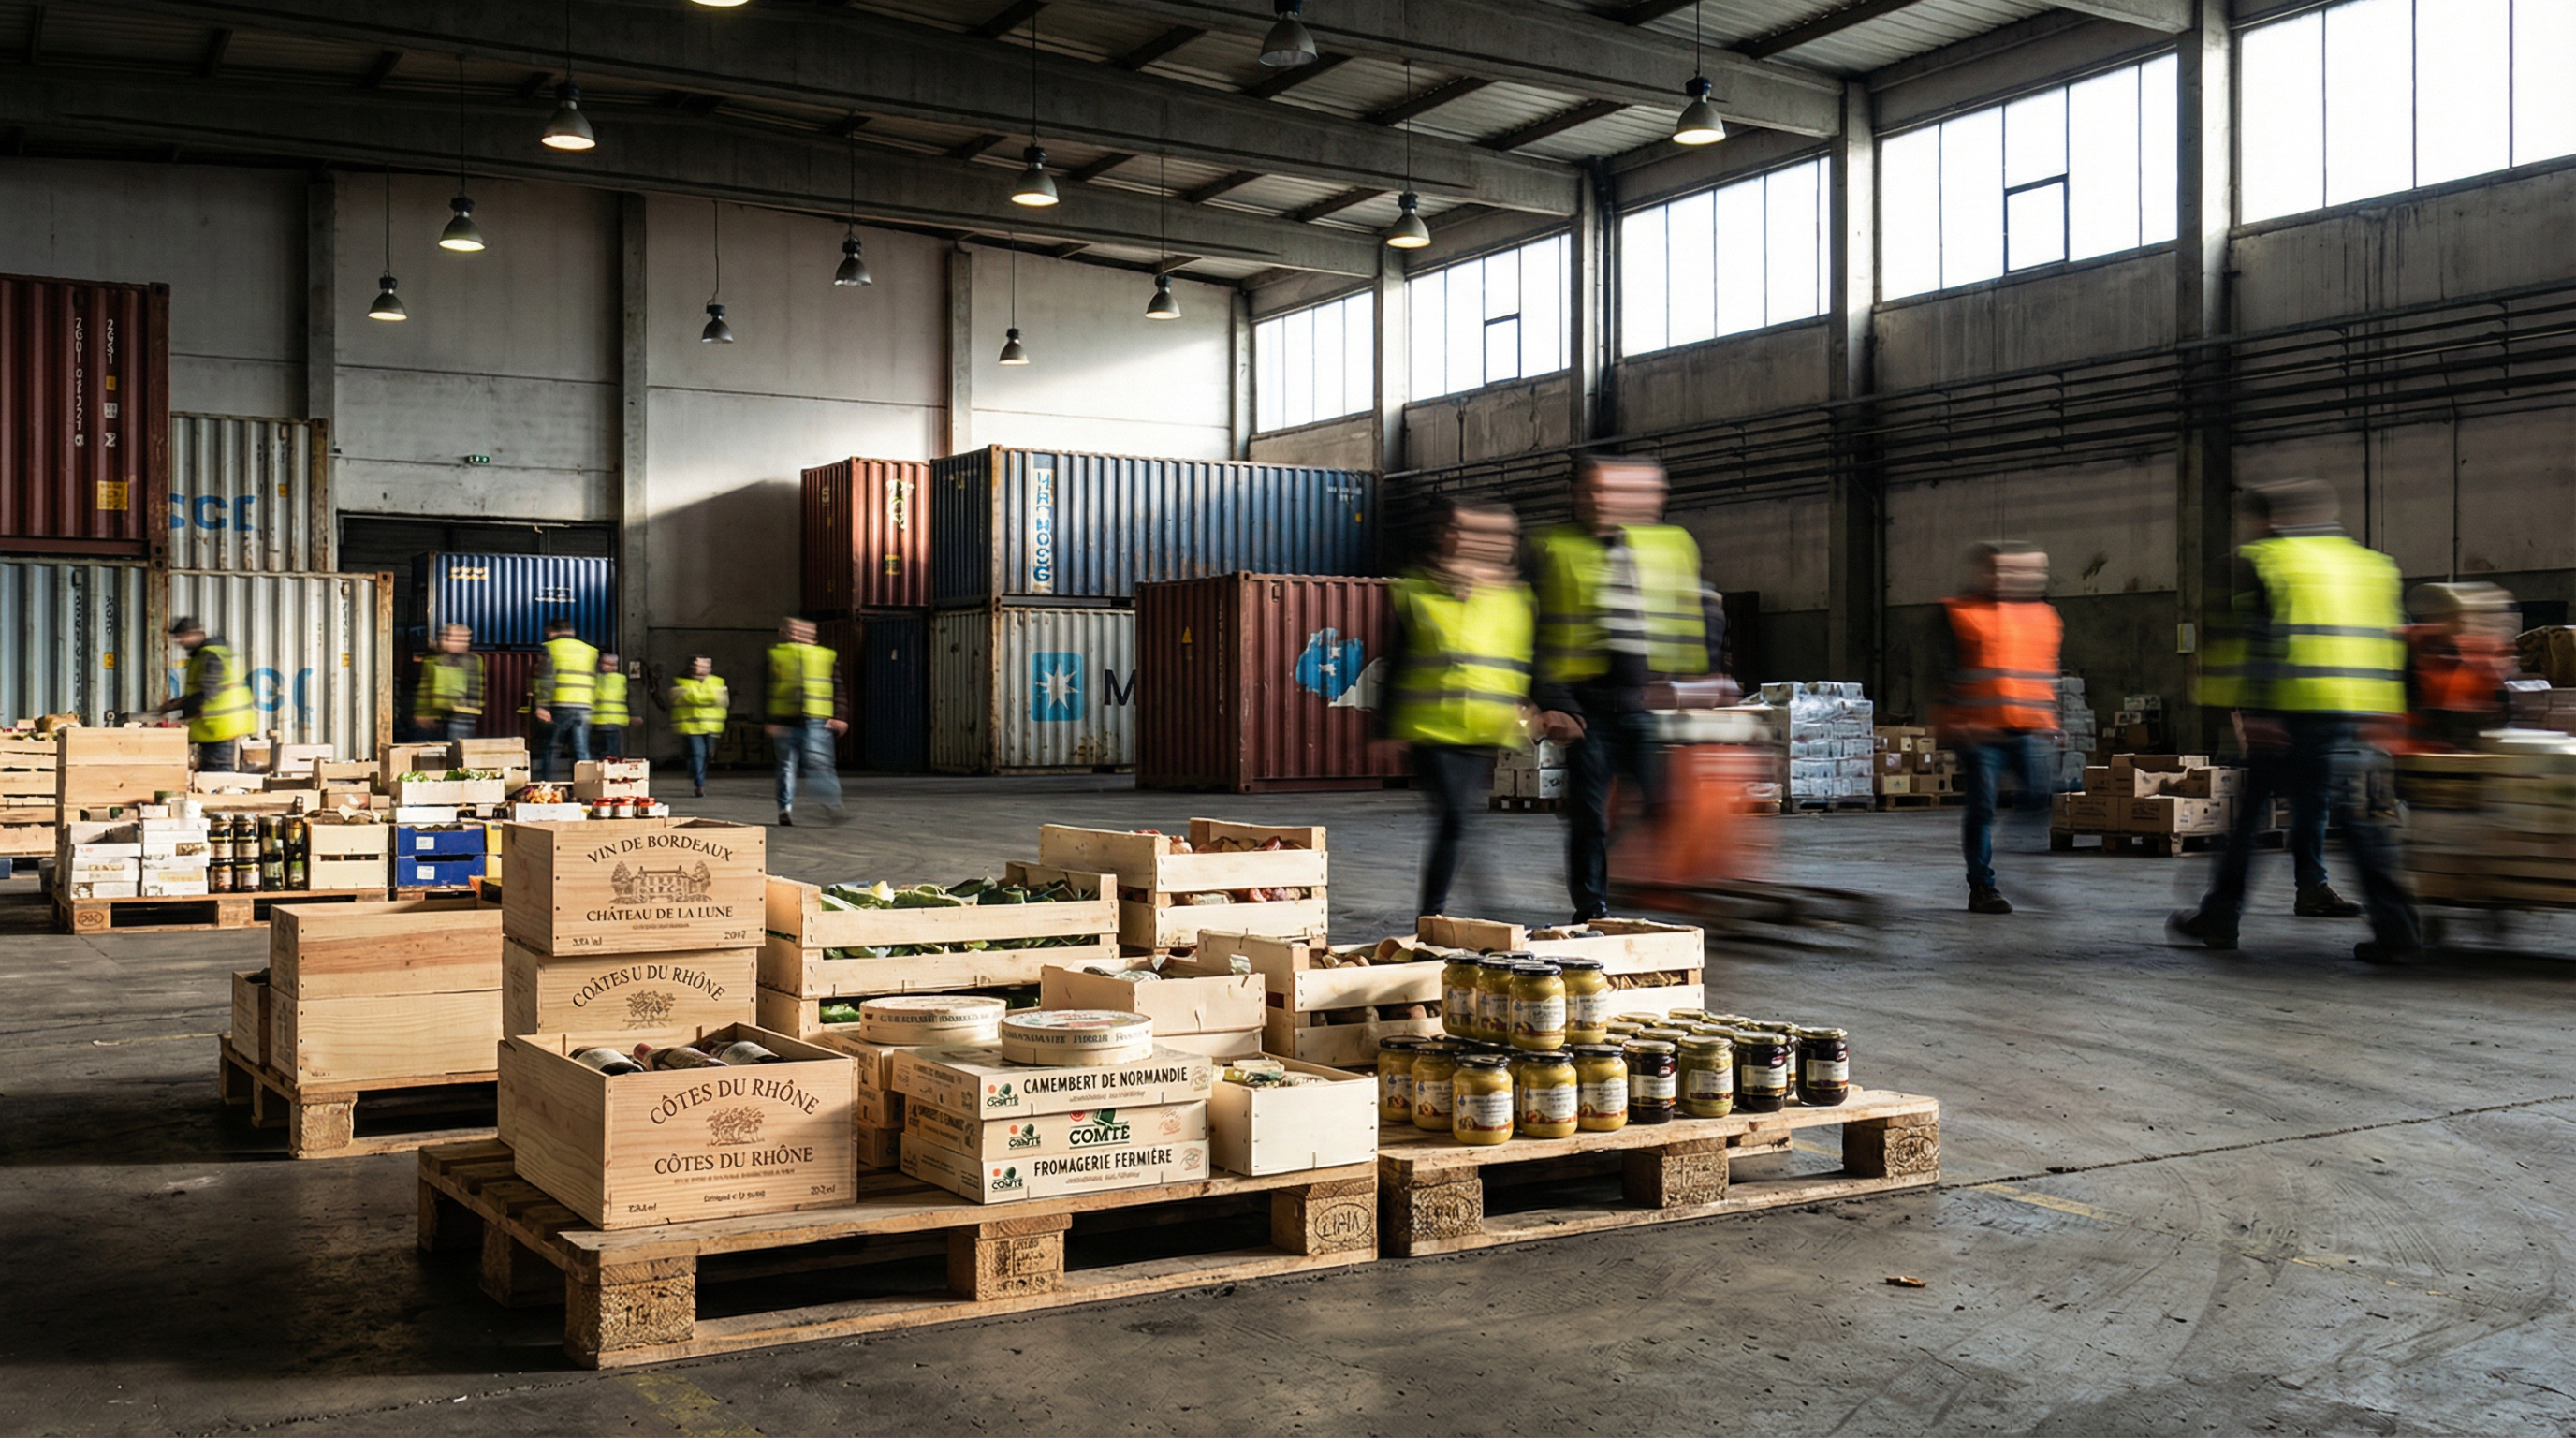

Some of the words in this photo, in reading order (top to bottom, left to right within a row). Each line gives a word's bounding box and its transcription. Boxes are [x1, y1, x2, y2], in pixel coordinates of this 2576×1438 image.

[587, 844, 618, 864] VIN
[621, 837, 644, 854] DE
[648, 834, 733, 862] BORDEAUX
[656, 907, 674, 919] DE
[678, 907, 695, 918] LA
[698, 905, 733, 918] LUNE
[647, 965, 668, 980] DU
[672, 967, 725, 1002] RHÔNE
[1023, 1074, 1098, 1094] CAMEMBERT
[1102, 1072, 1116, 1088] DE
[1120, 1067, 1188, 1087] NORMANDIE
[650, 1083, 713, 1125] CÔTES
[718, 1078, 747, 1098] DU
[752, 1078, 820, 1115] RHÔNE
[654, 1153, 714, 1175] CÔTES
[720, 1152, 746, 1169] DU
[751, 1144, 814, 1167] RHÔNE
[1033, 1154, 1111, 1177] FROMAGERIE
